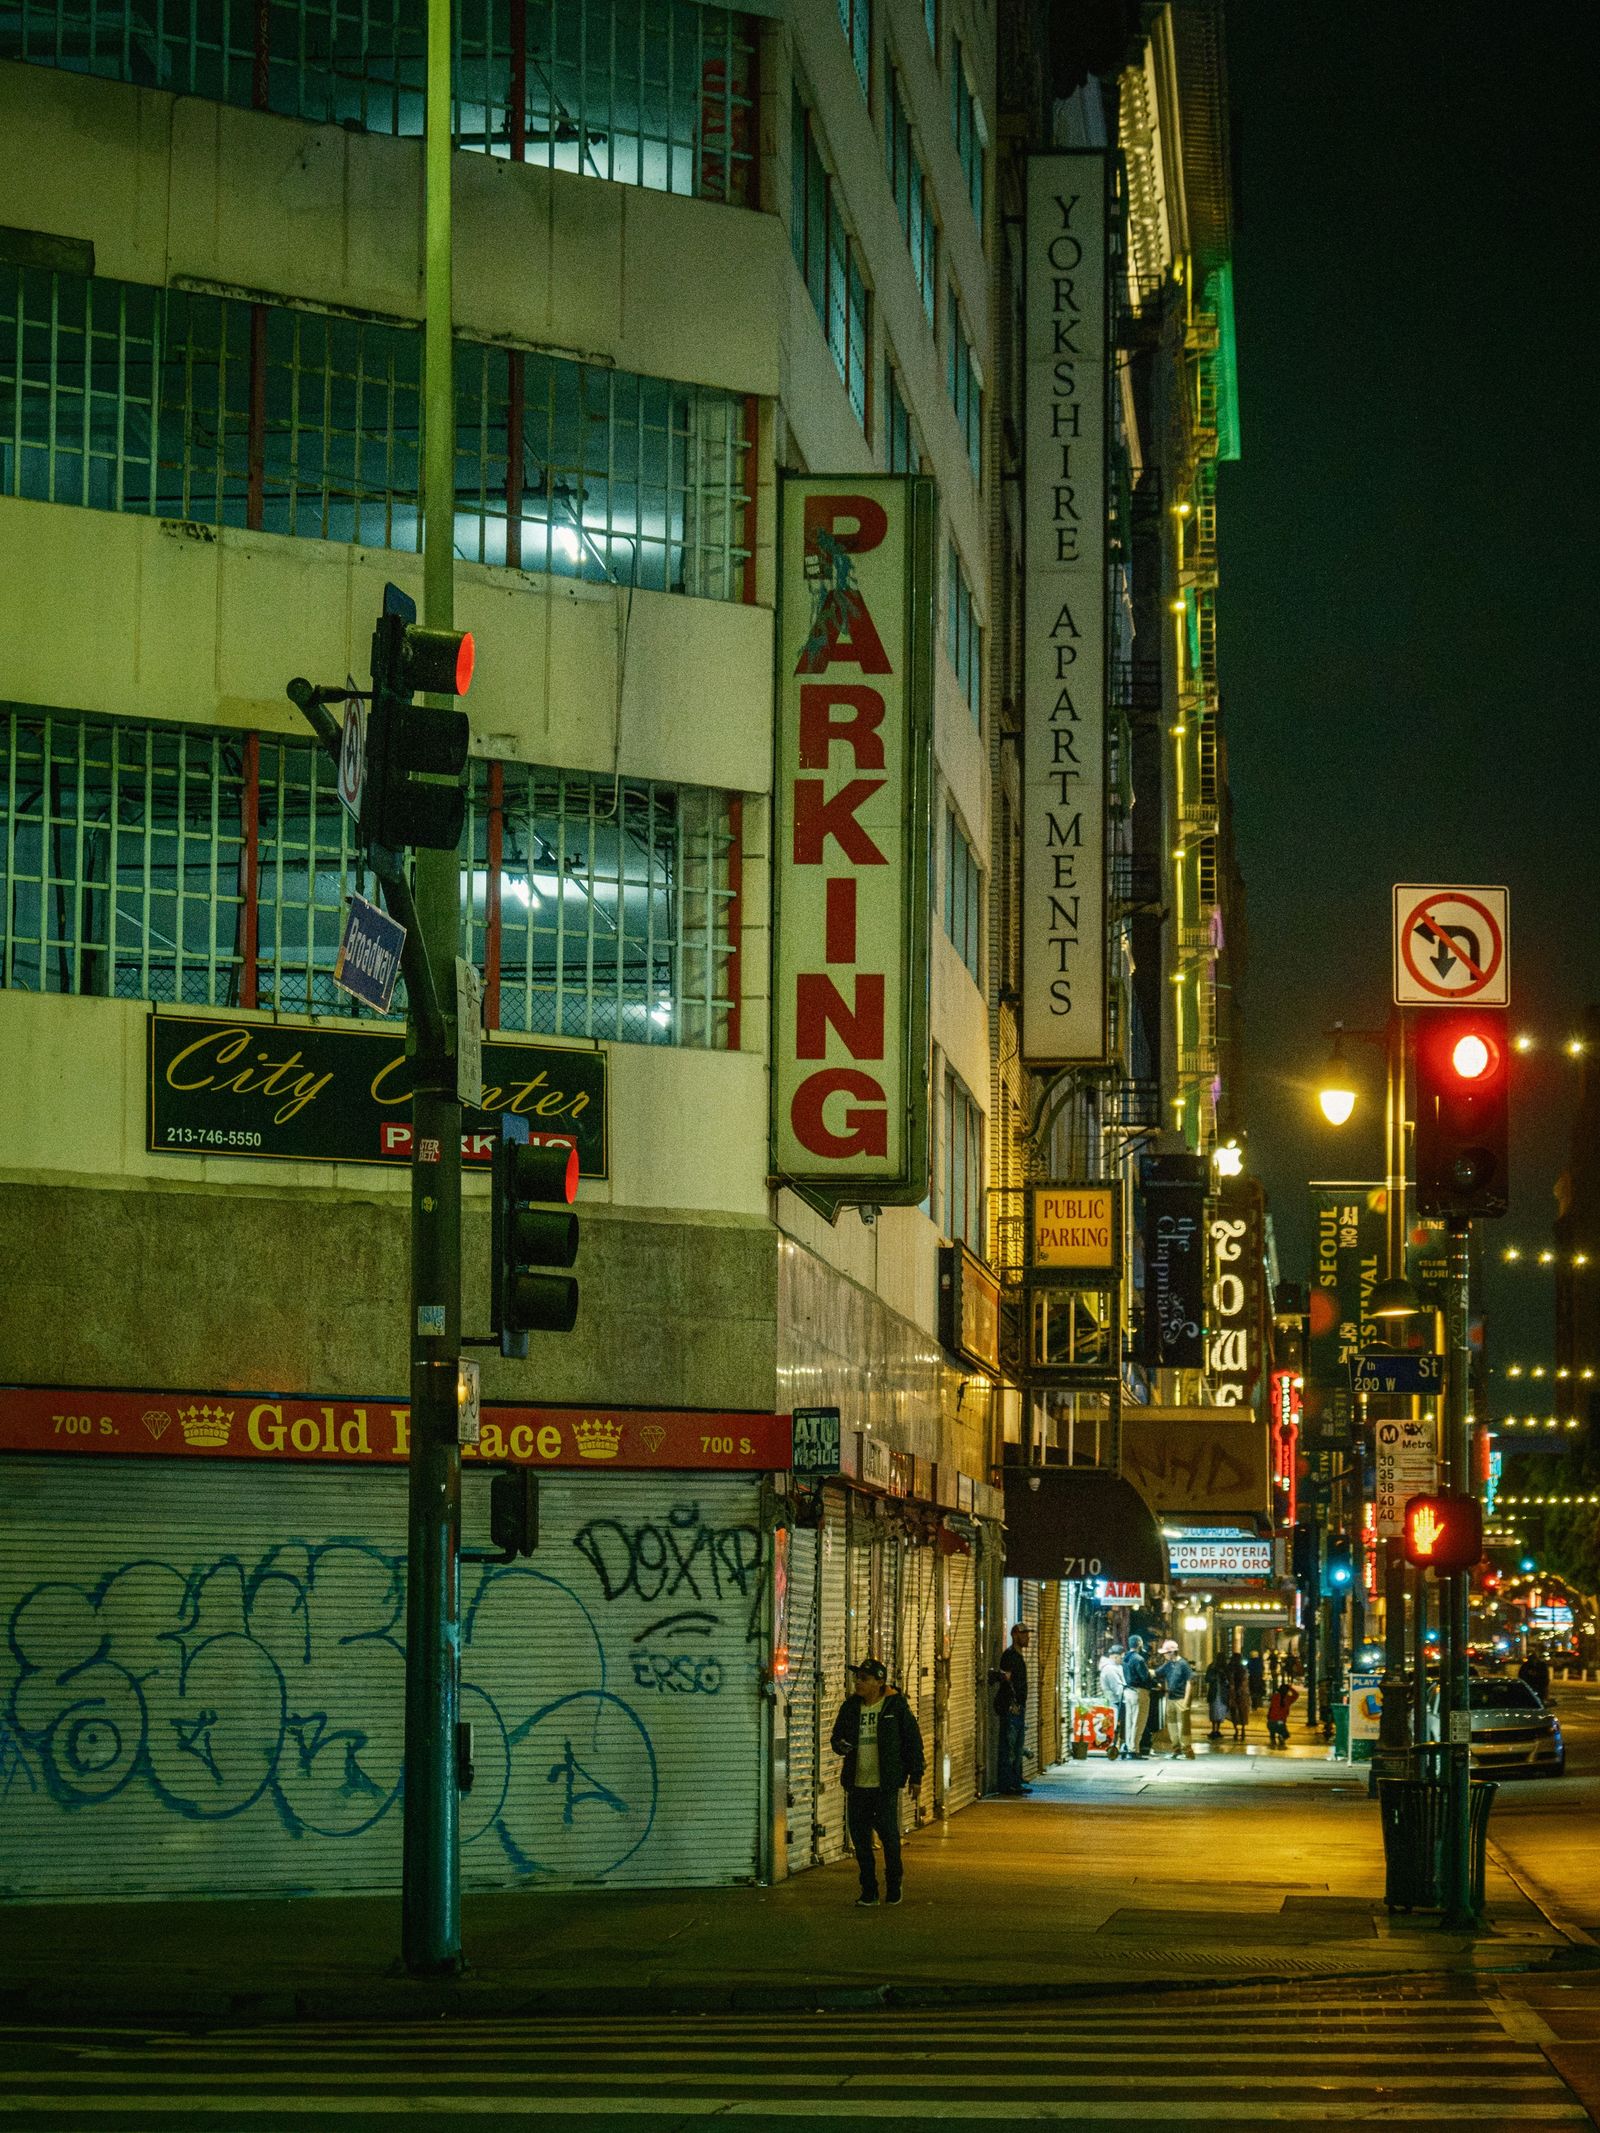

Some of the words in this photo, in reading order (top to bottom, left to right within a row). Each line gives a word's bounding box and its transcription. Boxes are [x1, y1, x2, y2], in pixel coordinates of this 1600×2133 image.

[1046, 195, 1084, 562] YORKSHIRE
[1045, 603, 1083, 1016] APARTMENTS
[791, 495, 893, 1160] PARKING
[345, 917, 396, 999] Broadway
[166, 1029, 334, 1125] City
[370, 1055, 590, 1118] Cnter
[167, 1127, 262, 1147] 213-746-5550
[1043, 1199, 1105, 1220] PUBLIC
[1040, 1227, 1109, 1248] PARKING
[1319, 1206, 1338, 1287] SEOUL
[1353, 1356, 1376, 1377] 7th
[1418, 1357, 1439, 1378] St
[1353, 1377, 1380, 1392] 200
[1385, 1377, 1397, 1392] W
[52, 1415, 92, 1435] 700
[99, 1416, 120, 1436] S.
[247, 1403, 373, 1454] Gold
[390, 1409, 562, 1459] Pace
[794, 1417, 839, 1443] ATM
[700, 1435, 734, 1454] 700
[738, 1437, 756, 1455] S.
[1402, 1439, 1433, 1449] Metro
[1379, 1455, 1395, 1467] 30
[1379, 1469, 1395, 1480] 35
[1379, 1482, 1395, 1493] 38
[1379, 1495, 1395, 1507] 40
[1379, 1509, 1395, 1520] 40
[1201, 1546, 1216, 1557] DE
[1219, 1546, 1268, 1557] JOYERIA
[1063, 1557, 1101, 1576] 710
[1180, 1558, 1237, 1569] COMPRO
[1242, 1558, 1271, 1569] ORO
[1104, 1581, 1142, 1598] ATM
